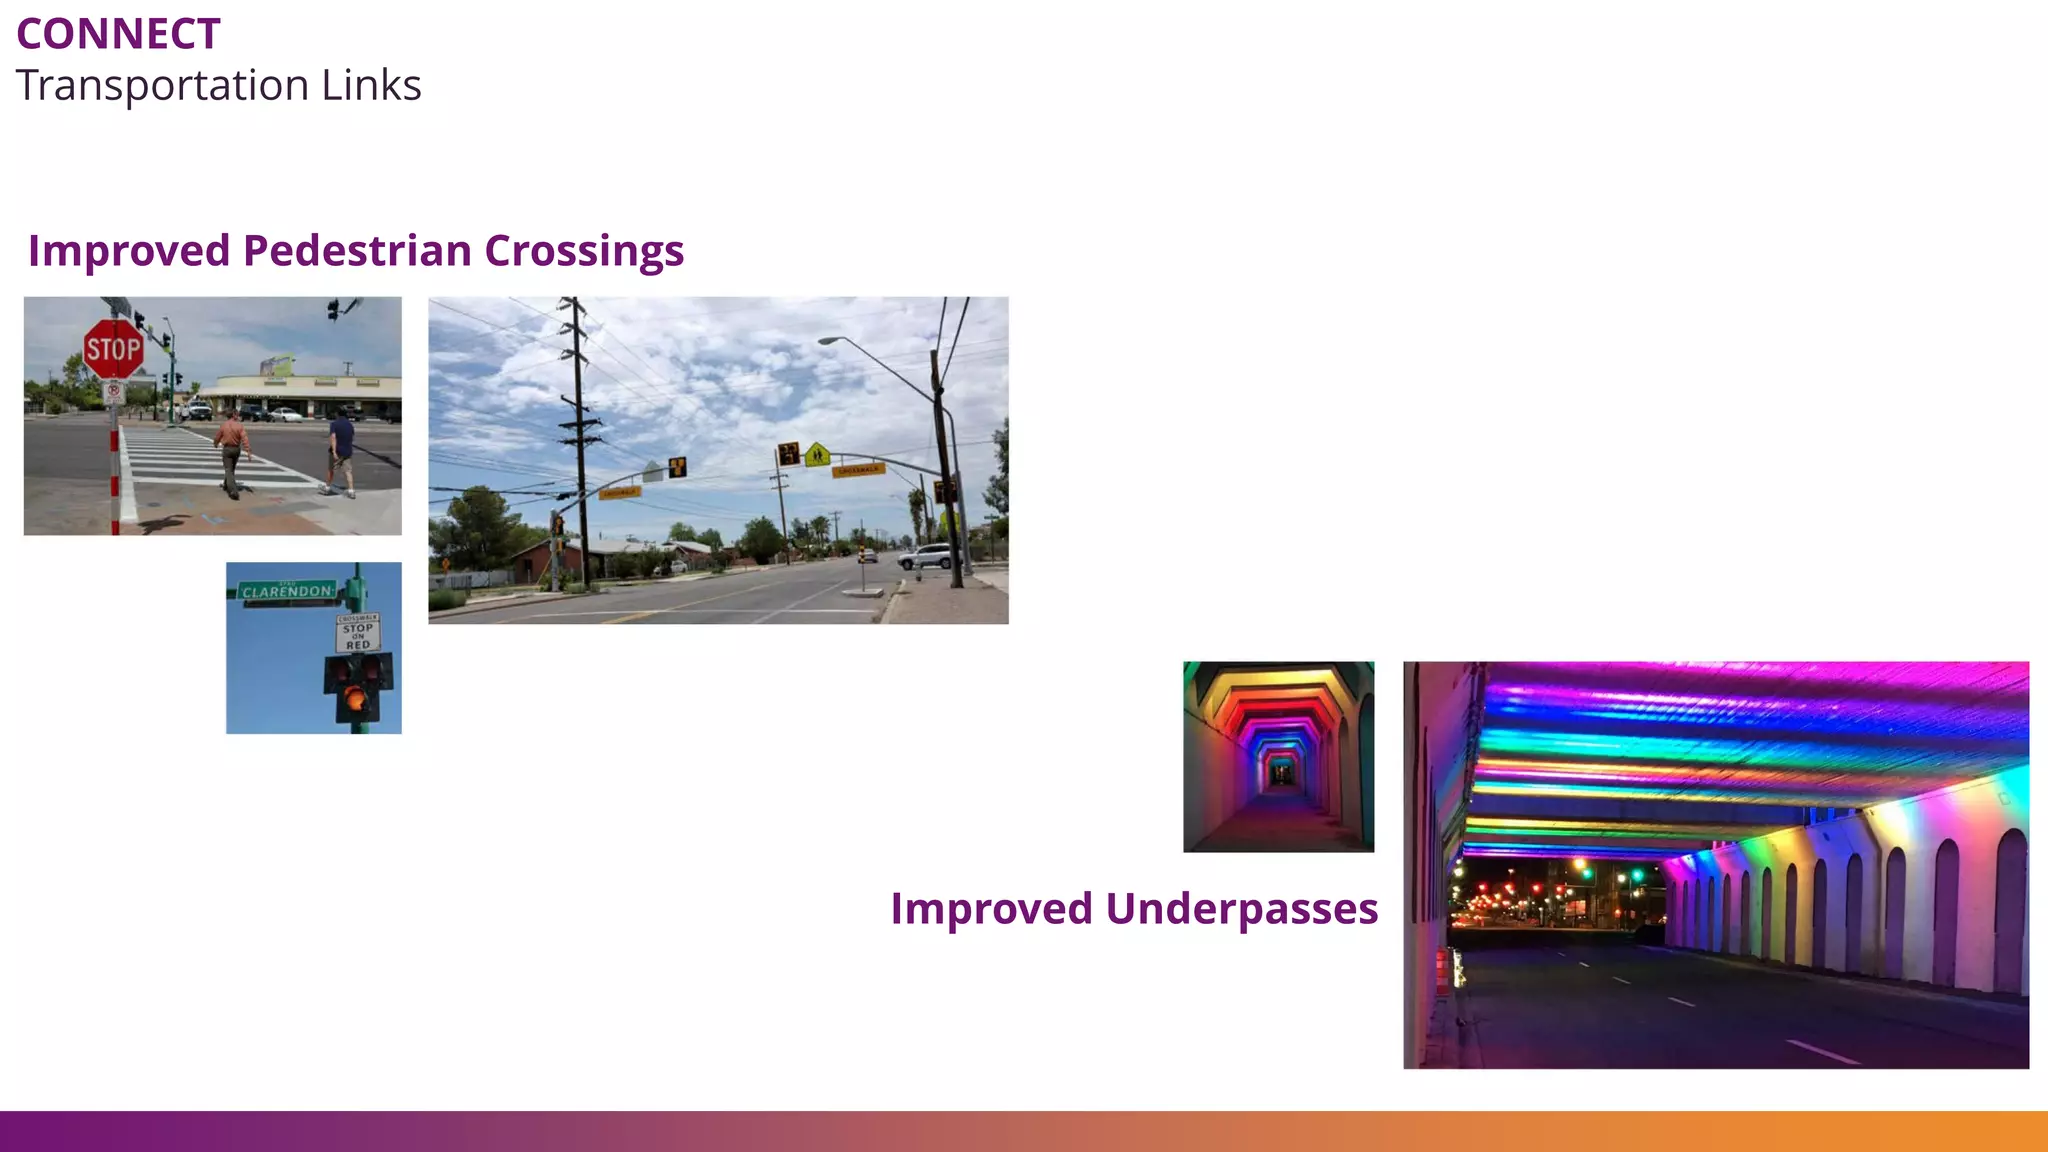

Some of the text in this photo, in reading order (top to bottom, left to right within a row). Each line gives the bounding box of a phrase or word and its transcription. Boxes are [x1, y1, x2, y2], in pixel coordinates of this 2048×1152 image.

[87, 337, 141, 361] STOP
[242, 585, 332, 599] CLARENDON
[342, 623, 373, 634] STOP
[346, 640, 371, 650] RED
